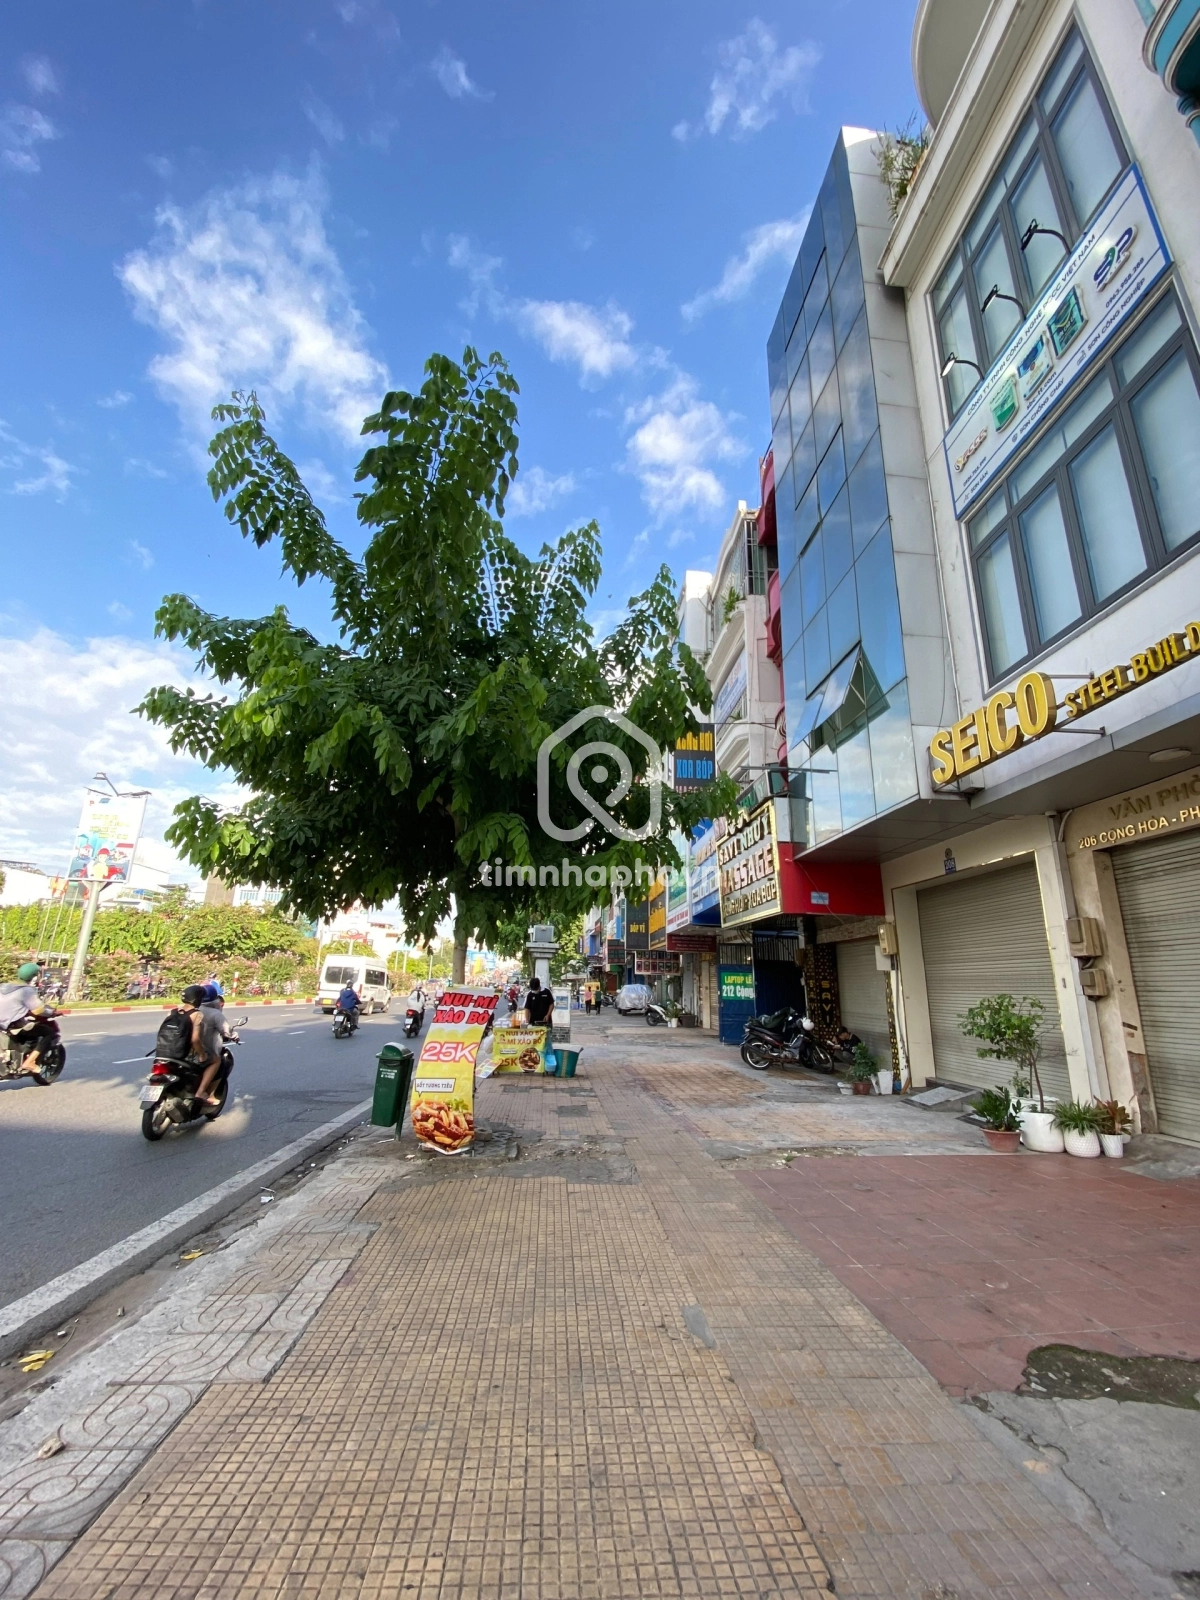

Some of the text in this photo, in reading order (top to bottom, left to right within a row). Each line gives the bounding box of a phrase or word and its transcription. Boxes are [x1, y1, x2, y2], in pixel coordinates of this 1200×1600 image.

[989, 362, 1006, 385] TNHH
[1005, 337, 1023, 361] CÔNG
[1061, 260, 1078, 282] VIỆT
[1078, 234, 1096, 260] NAM
[1101, 310, 1120, 334] CÔNG
[1120, 277, 1146, 311] NGHIỆP
[930, 671, 1055, 784] SEICO
[1064, 664, 1132, 718] STEEL
[676, 757, 713, 779] XOA BÓP
[1108, 795, 1152, 820] VĂN
[1079, 835, 1097, 849] 206
[1099, 825, 1135, 844] CỘNG
[1138, 815, 1169, 834] HÒA
[719, 838, 739, 866] SAVI
[720, 842, 774, 896] MASSAGE
[722, 984, 735, 997] 212
[724, 975, 745, 984] LAPTOP
[421, 1040, 480, 1063] 25K
